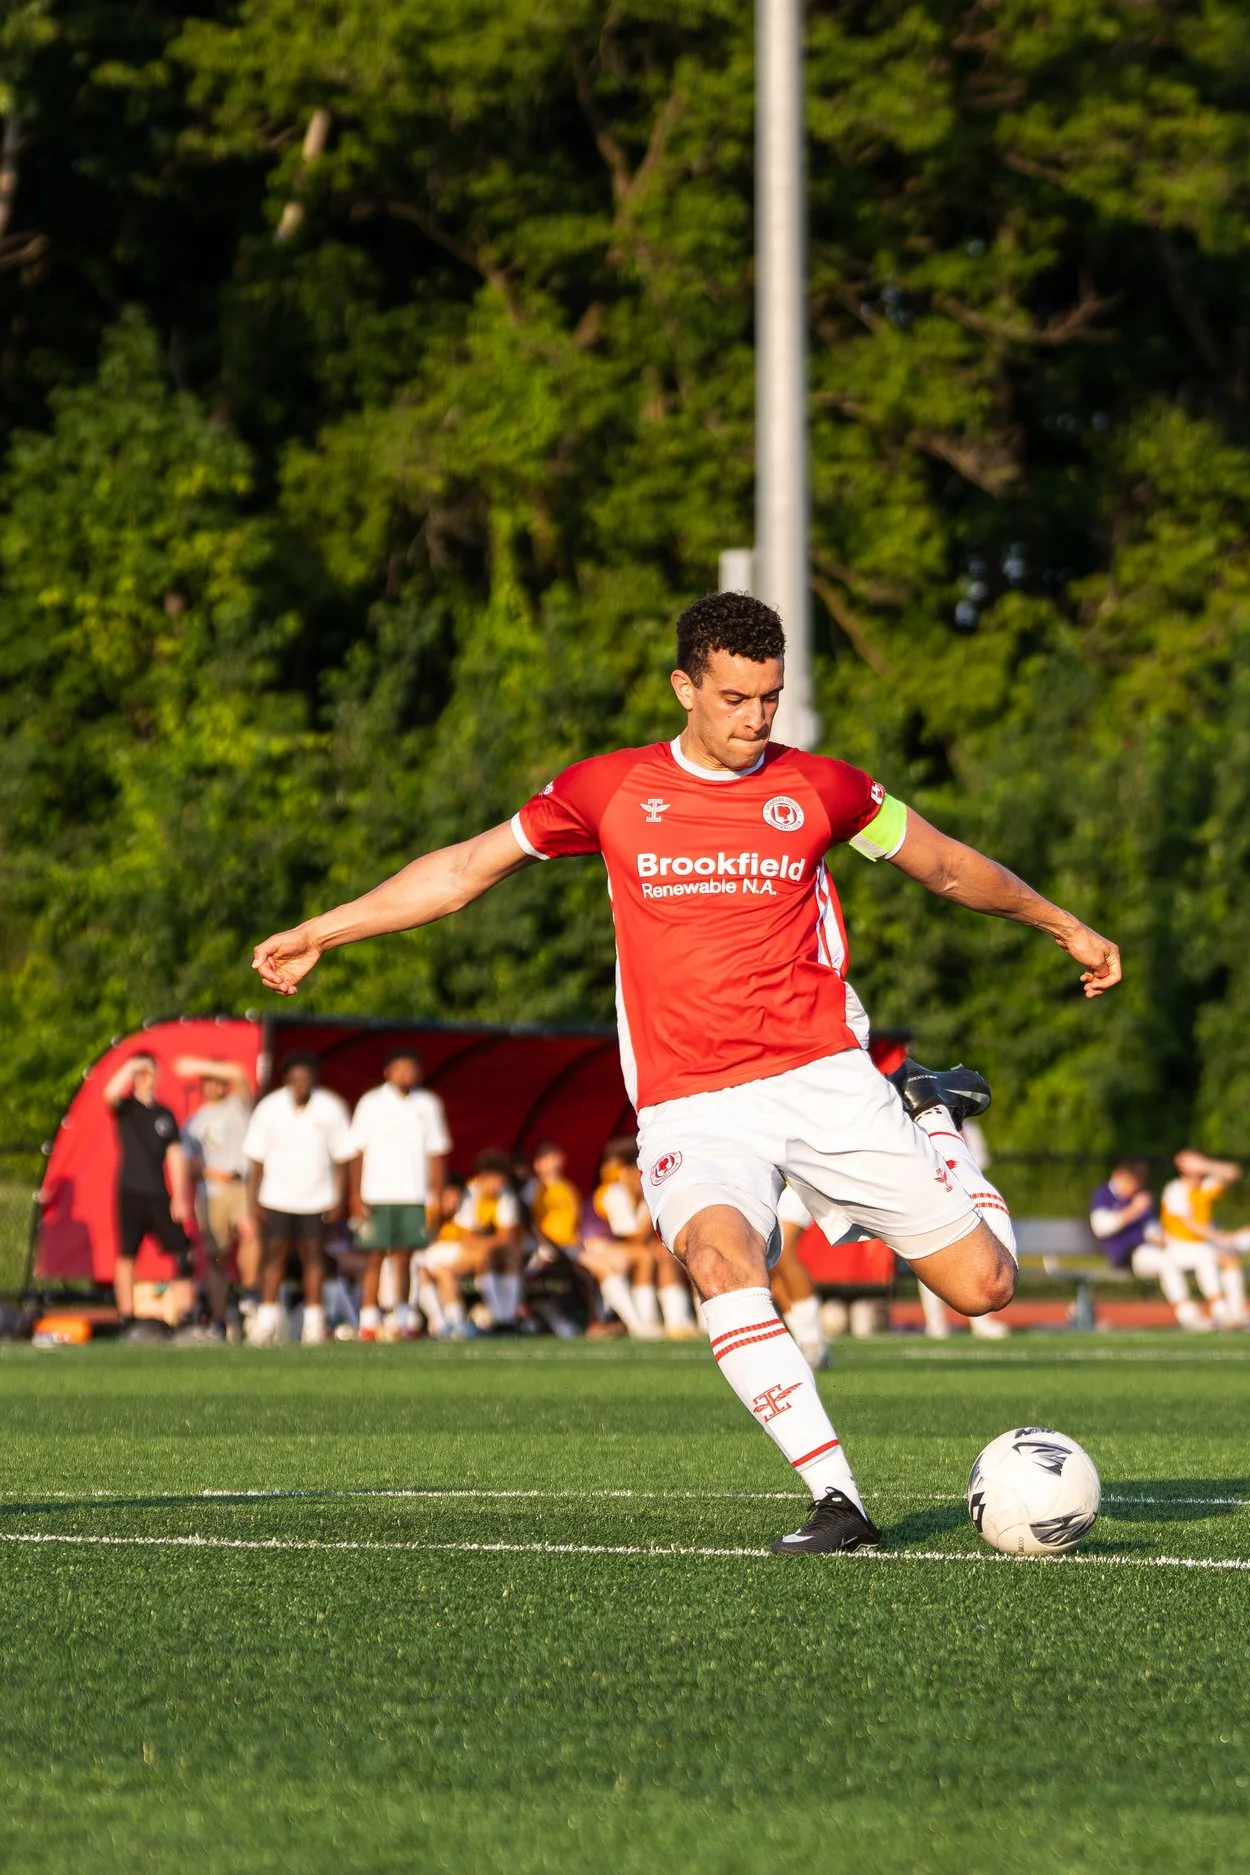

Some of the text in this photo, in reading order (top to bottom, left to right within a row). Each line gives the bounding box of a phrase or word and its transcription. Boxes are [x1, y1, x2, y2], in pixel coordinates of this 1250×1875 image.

[637, 852, 806, 881] Brookfield
[641, 878, 777, 899] Renewable N.A.
